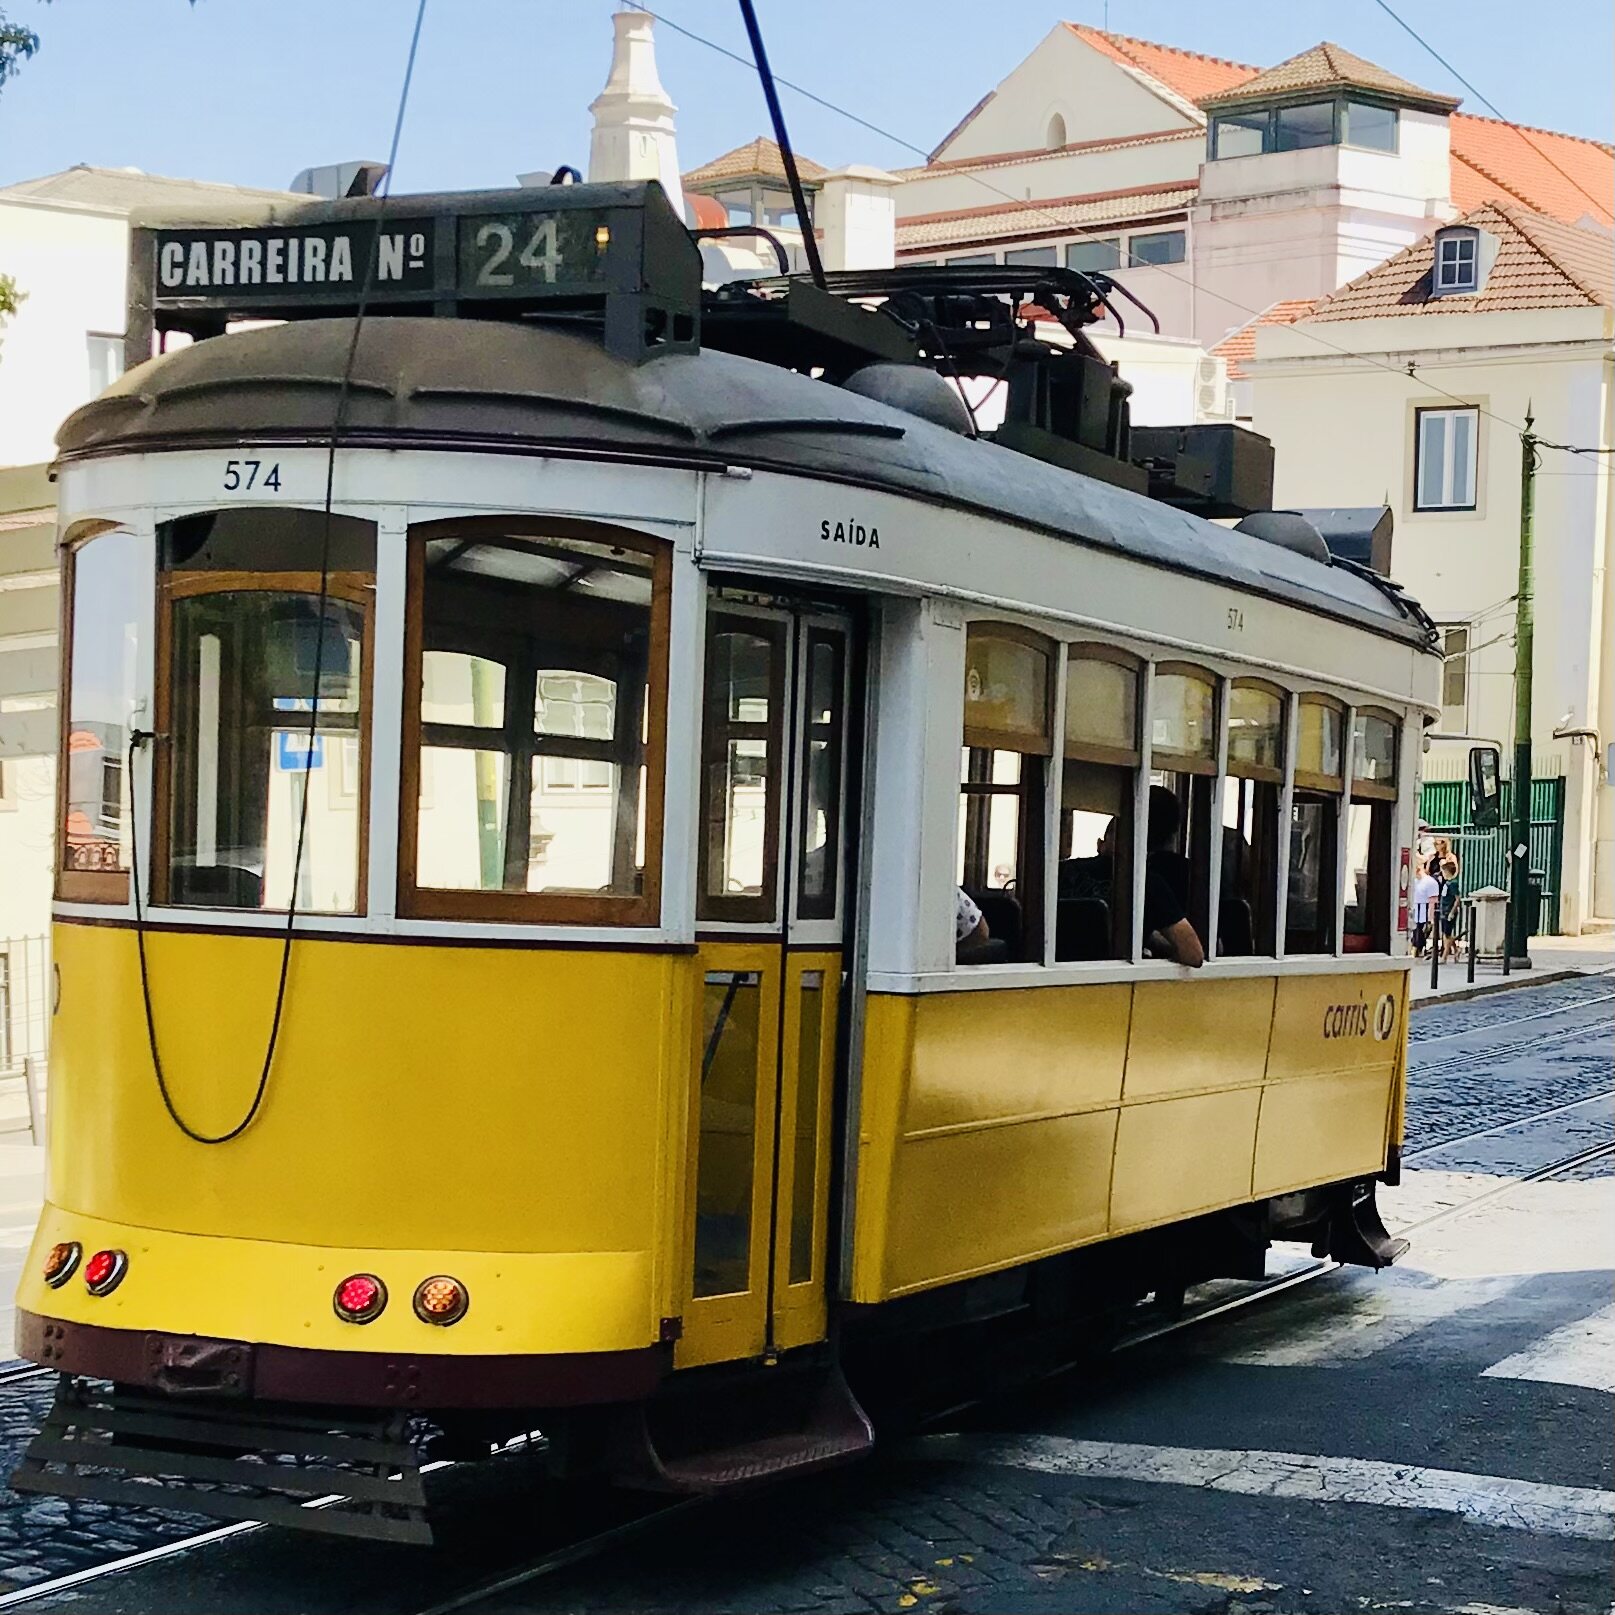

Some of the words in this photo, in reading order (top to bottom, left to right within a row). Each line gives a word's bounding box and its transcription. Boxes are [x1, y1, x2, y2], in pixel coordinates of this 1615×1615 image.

[160, 235, 353, 288] CARREIRA
[475, 218, 563, 287] 24
[224, 460, 282, 492] 574
[821, 518, 880, 549] SAÍDA
[1228, 608, 1243, 632] 574
[1324, 989, 1368, 1039] carris
